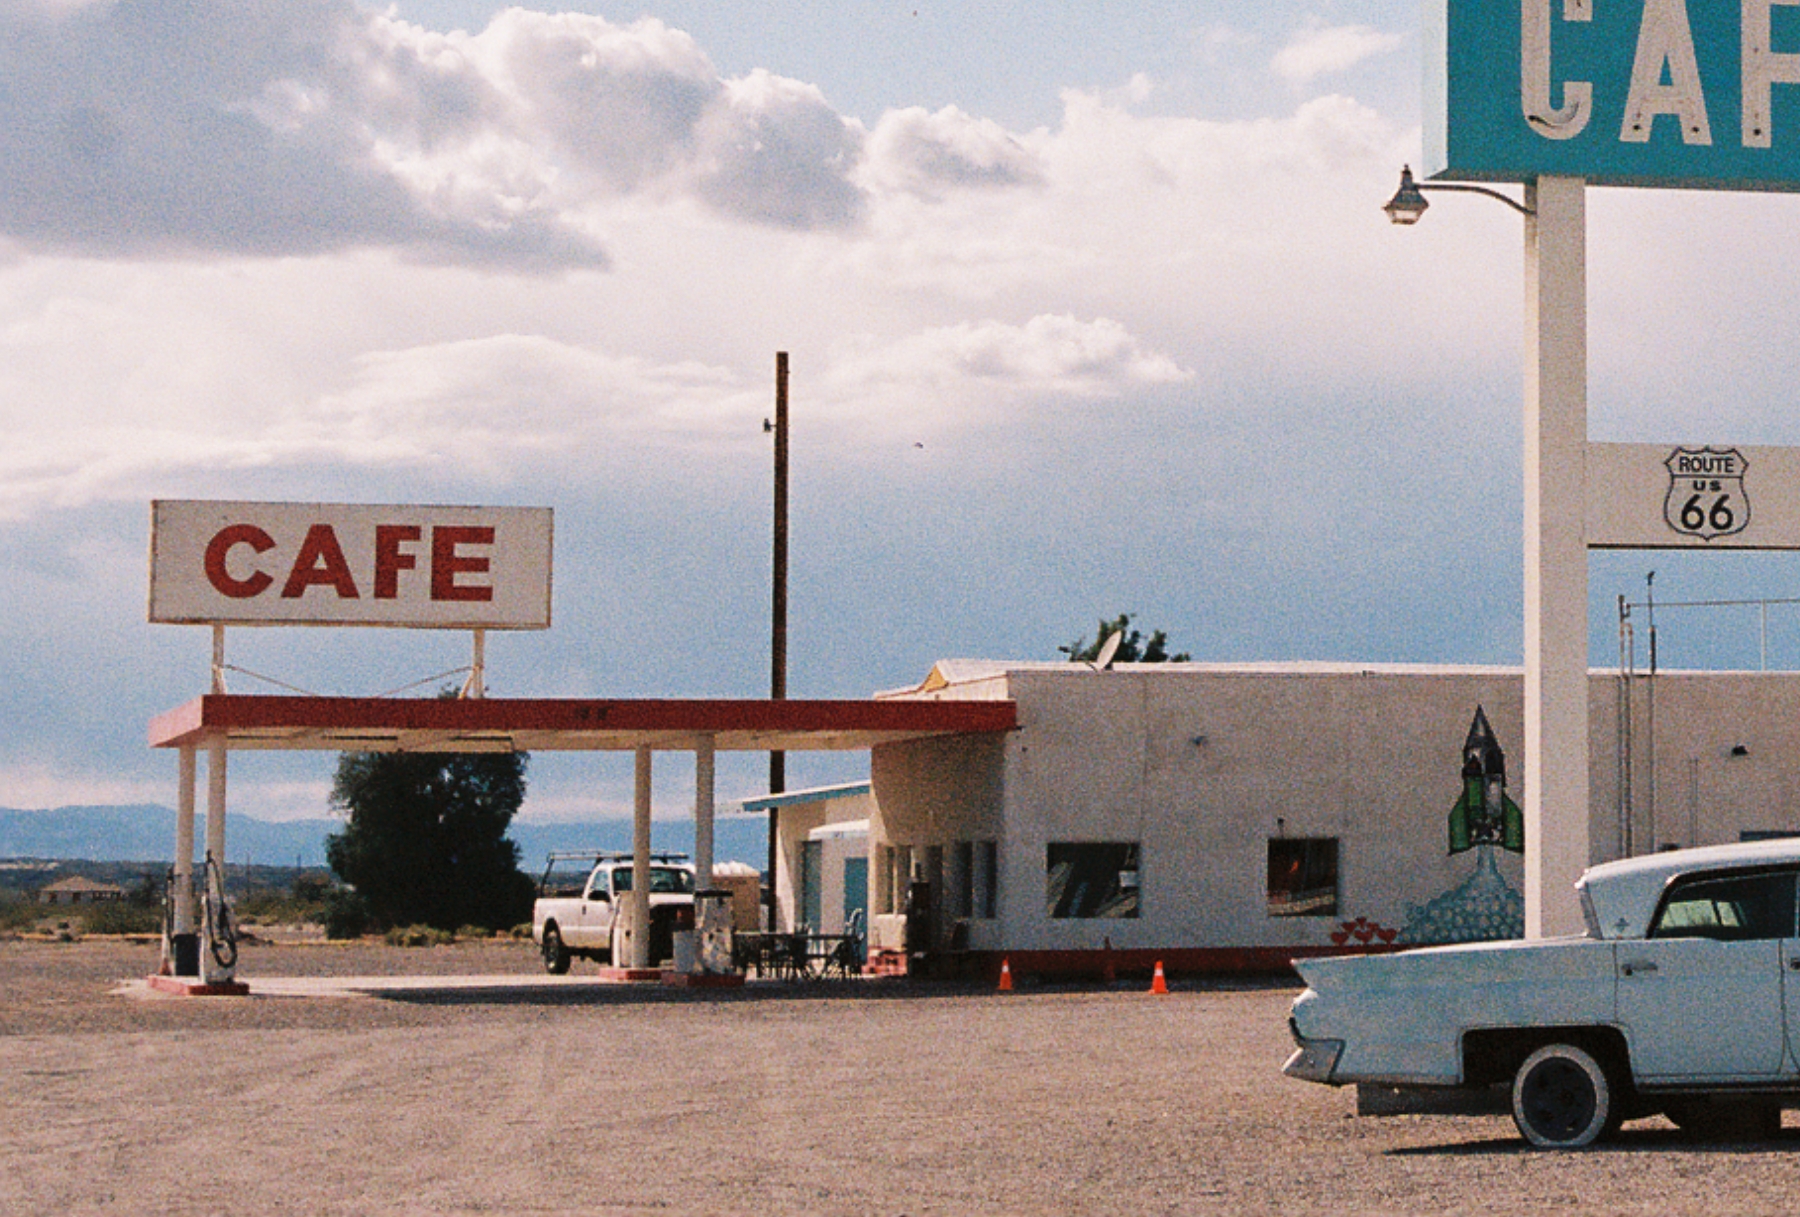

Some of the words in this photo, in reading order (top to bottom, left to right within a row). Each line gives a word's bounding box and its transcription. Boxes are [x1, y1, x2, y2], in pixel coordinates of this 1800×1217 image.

[1679, 456, 1734, 473] ROUTE
[1681, 494, 1733, 530] 66
[204, 523, 496, 602] CAFE
